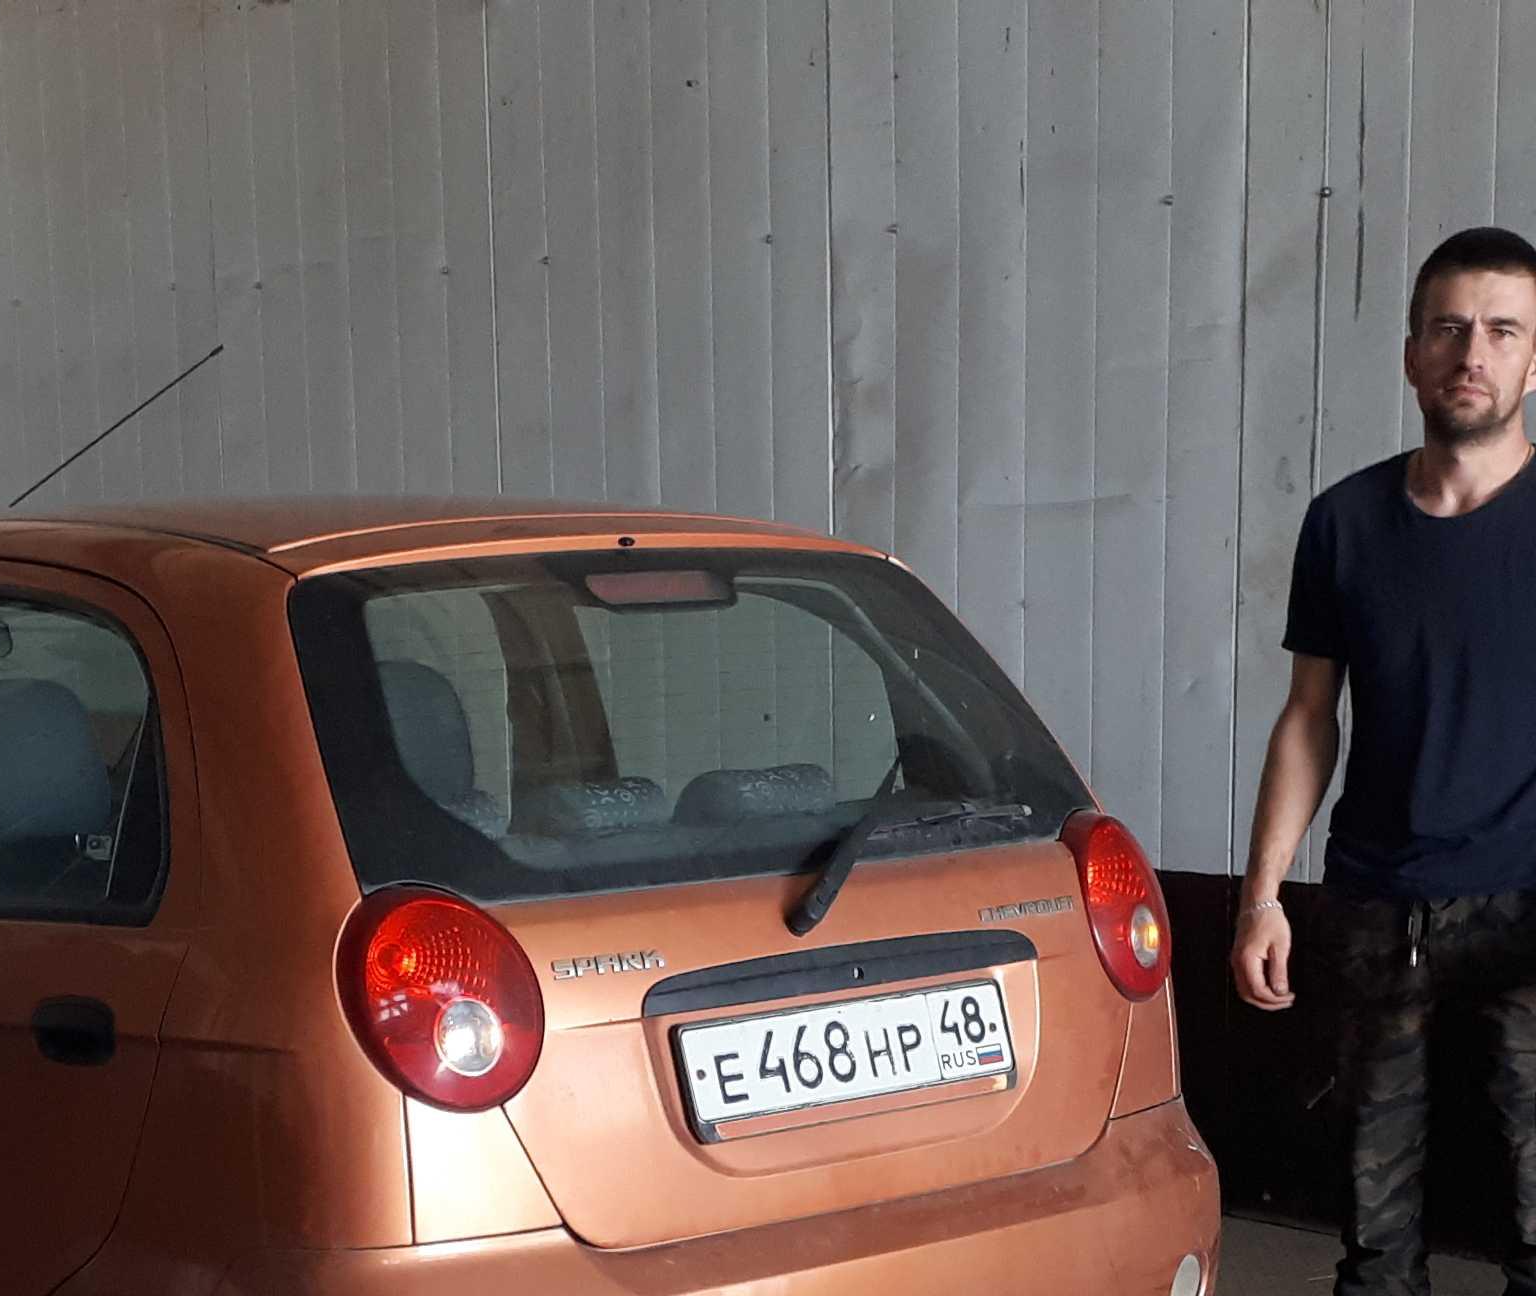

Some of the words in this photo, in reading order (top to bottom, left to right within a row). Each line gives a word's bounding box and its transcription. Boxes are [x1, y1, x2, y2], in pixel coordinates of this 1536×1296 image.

[552, 950, 665, 980] SPARK
[940, 996, 985, 1045] 48
[941, 1051, 977, 1070] RUS
